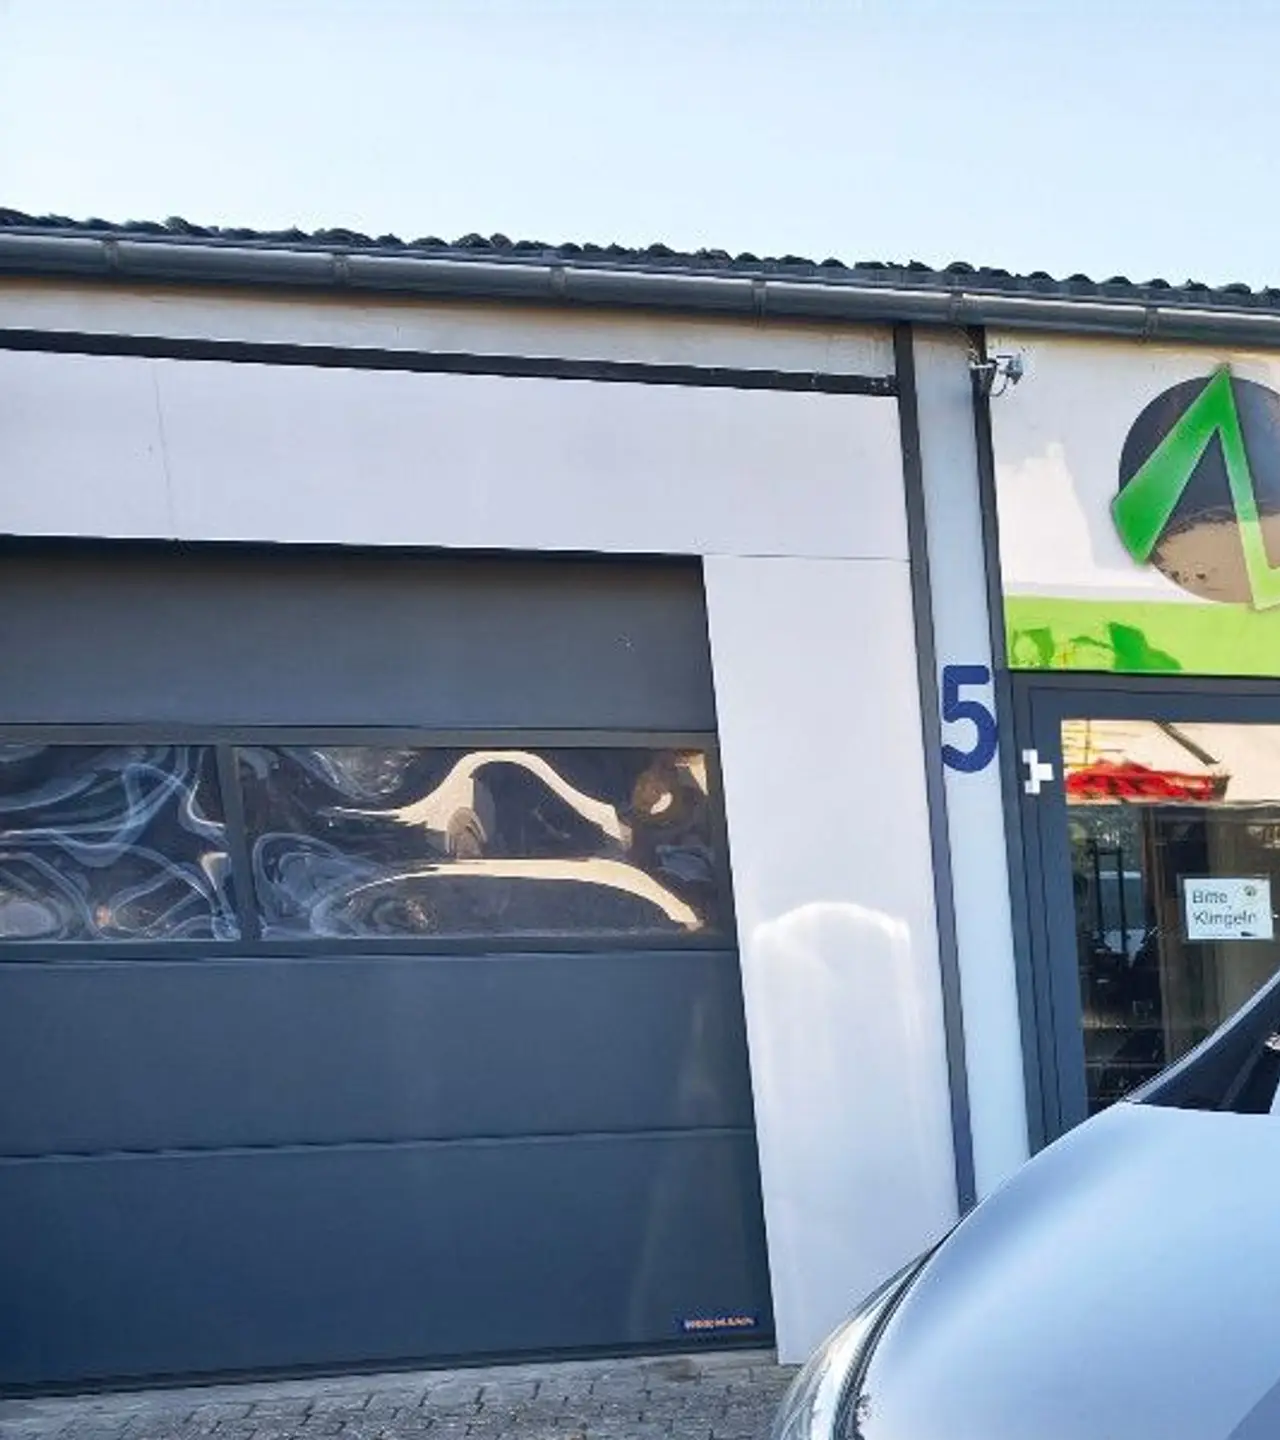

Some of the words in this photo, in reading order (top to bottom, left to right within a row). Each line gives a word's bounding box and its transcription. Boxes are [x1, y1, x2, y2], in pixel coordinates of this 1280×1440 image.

[941, 664, 998, 773] 5
[1192, 889, 1228, 904] Bitte
[1192, 909, 1257, 929] Klingeln
